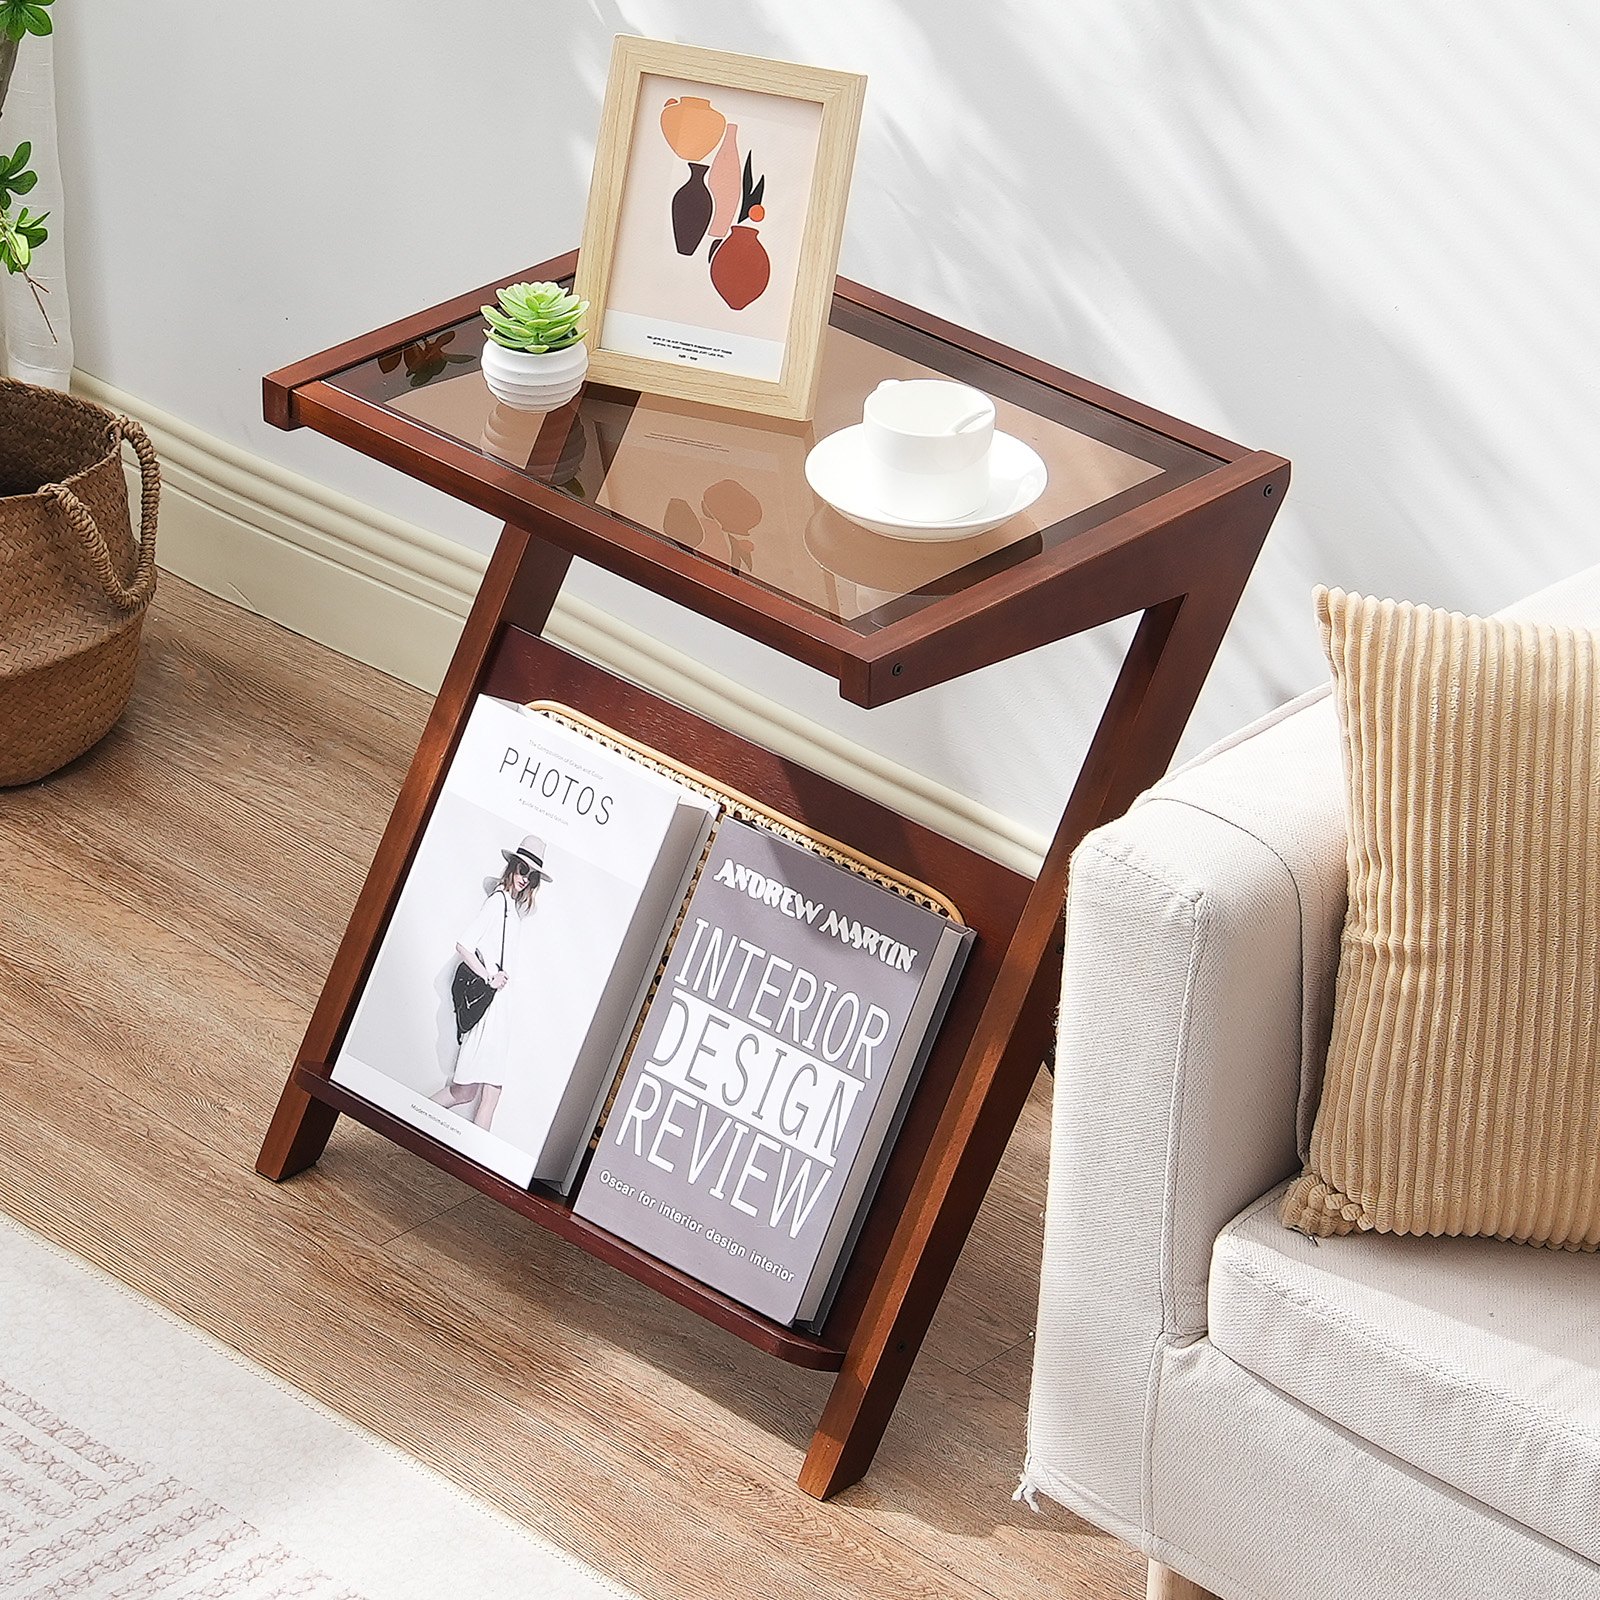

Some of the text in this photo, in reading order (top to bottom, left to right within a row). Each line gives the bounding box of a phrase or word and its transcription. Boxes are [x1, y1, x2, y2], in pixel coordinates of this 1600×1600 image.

[499, 746, 614, 825] PHOTOS
[713, 858, 918, 973] ANDREW MARTIN
[673, 917, 890, 1080] INTERIOR
[647, 993, 866, 1165] DESIGN
[615, 1073, 832, 1240] REVIEW
[600, 1170, 795, 1283] Oscar for interior design interior
